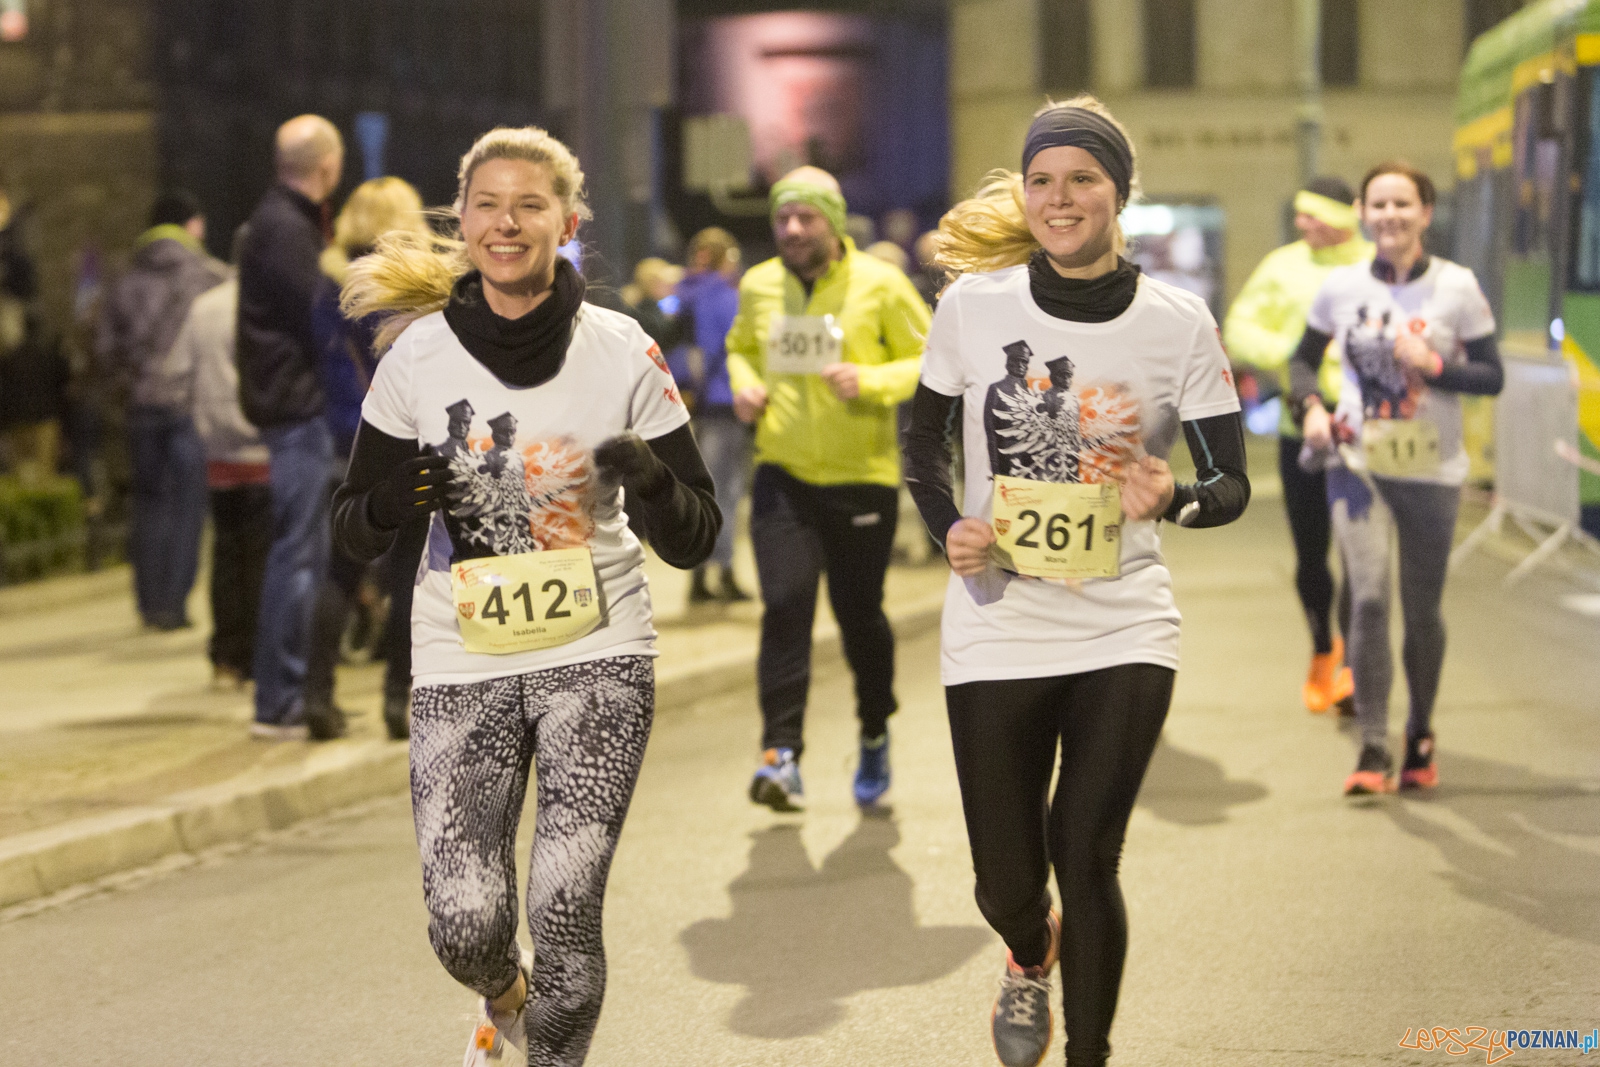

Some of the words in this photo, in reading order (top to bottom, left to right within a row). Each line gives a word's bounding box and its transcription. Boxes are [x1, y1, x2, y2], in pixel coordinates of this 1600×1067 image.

[781, 331, 822, 357] 501
[1388, 438, 1415, 461] 11
[1015, 509, 1095, 551] 261
[481, 578, 571, 625] 412
[512, 626, 547, 637] Isabella
